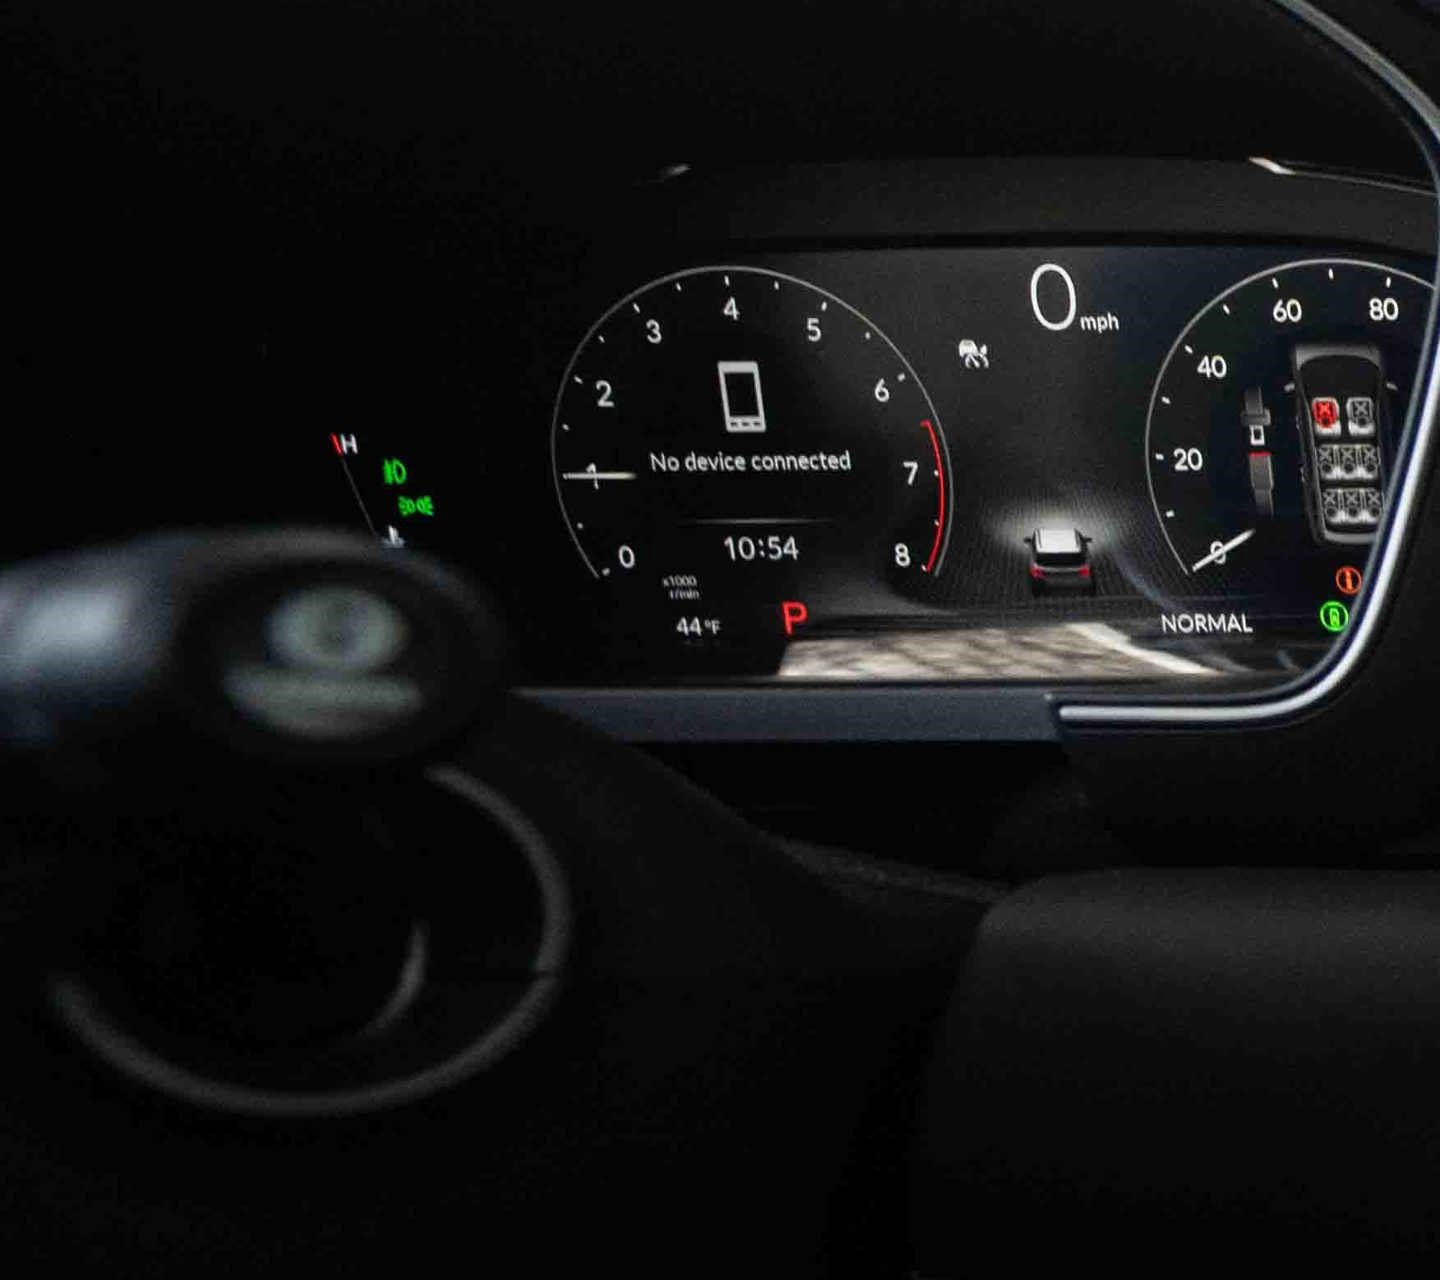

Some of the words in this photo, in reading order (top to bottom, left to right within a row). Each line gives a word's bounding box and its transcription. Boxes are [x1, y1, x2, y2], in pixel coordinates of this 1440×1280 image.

[724, 298, 739, 320] 4
[1030, 264, 1076, 331] 0
[1080, 313, 1119, 333] mph
[1369, 298, 1398, 320] 80
[1272, 299, 1302, 321] 60
[647, 321, 662, 343] 3
[806, 319, 821, 340] 5
[1197, 355, 1226, 377] 40
[596, 381, 615, 407] 2
[874, 380, 889, 402] 6
[341, 434, 357, 453] H
[650, 452, 680, 473] No
[685, 452, 745, 472] device
[751, 451, 851, 472] connected
[1172, 448, 1202, 470] 20
[903, 462, 918, 484] 7
[619, 546, 635, 568] 0
[724, 536, 799, 561] 10:54
[894, 544, 910, 566] 8
[782, 602, 807, 634] P
[1162, 615, 1253, 634] NORMAL
